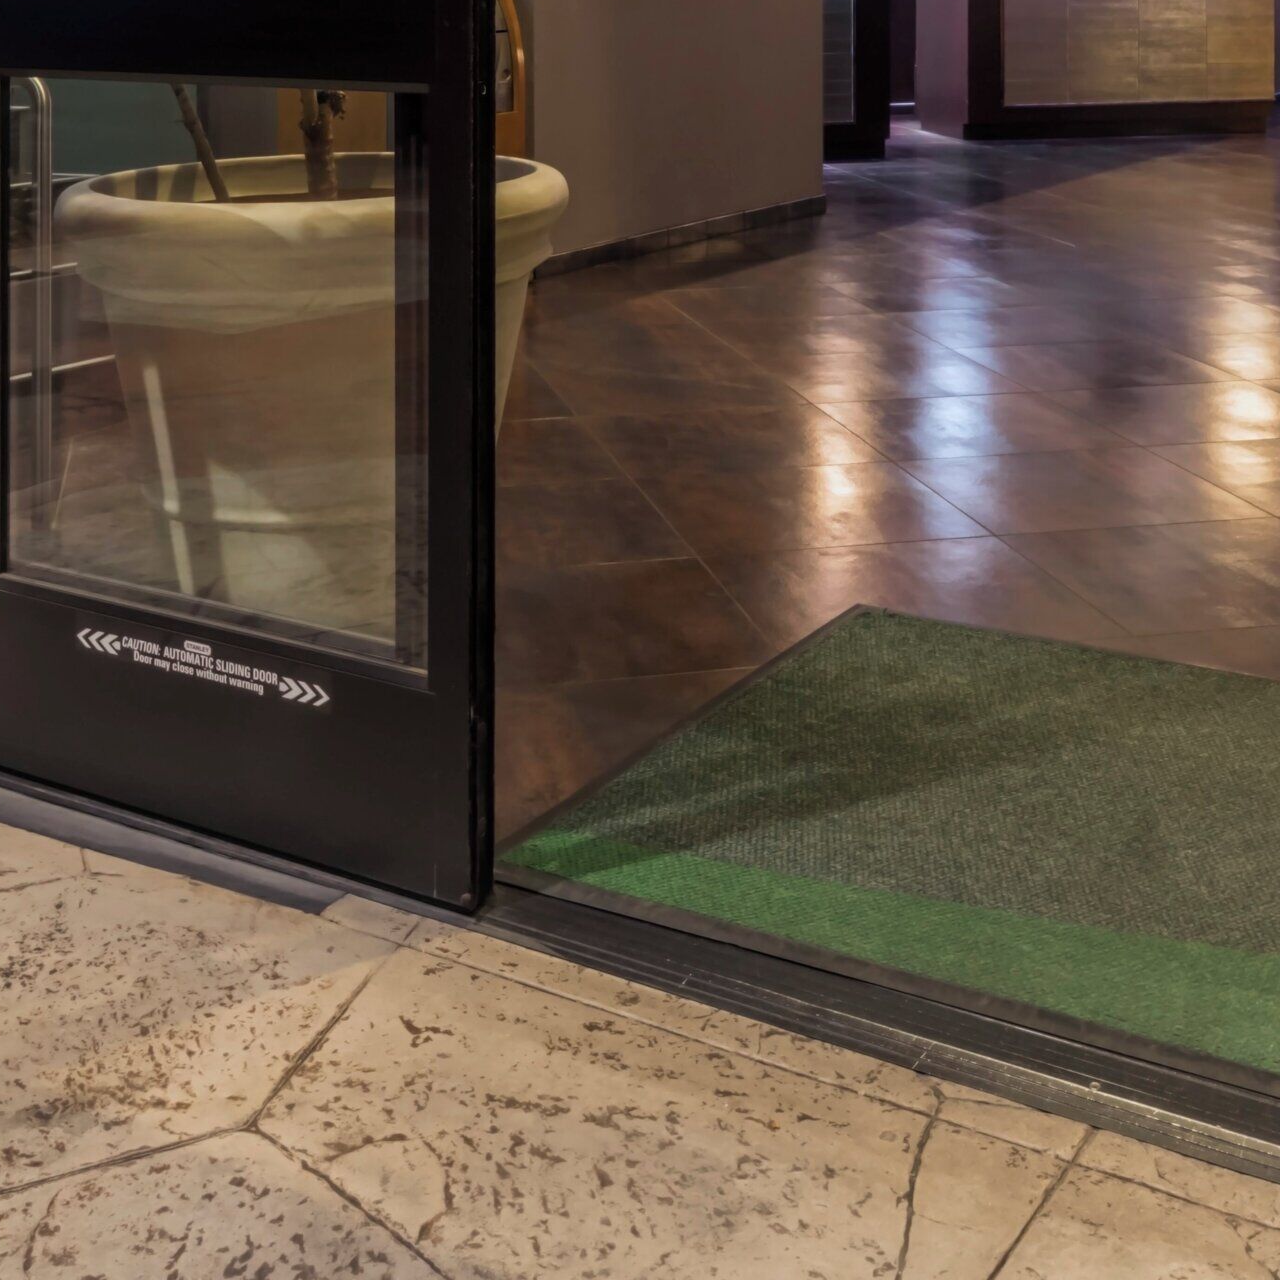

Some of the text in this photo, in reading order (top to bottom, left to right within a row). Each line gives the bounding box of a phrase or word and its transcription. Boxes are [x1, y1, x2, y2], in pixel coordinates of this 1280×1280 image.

[122, 635, 278, 686] CAUTION: AUTOMATIC SLIDING DOOR
[186, 641, 209, 653] STANLEY
[133, 650, 264, 696] Door may close without warning
